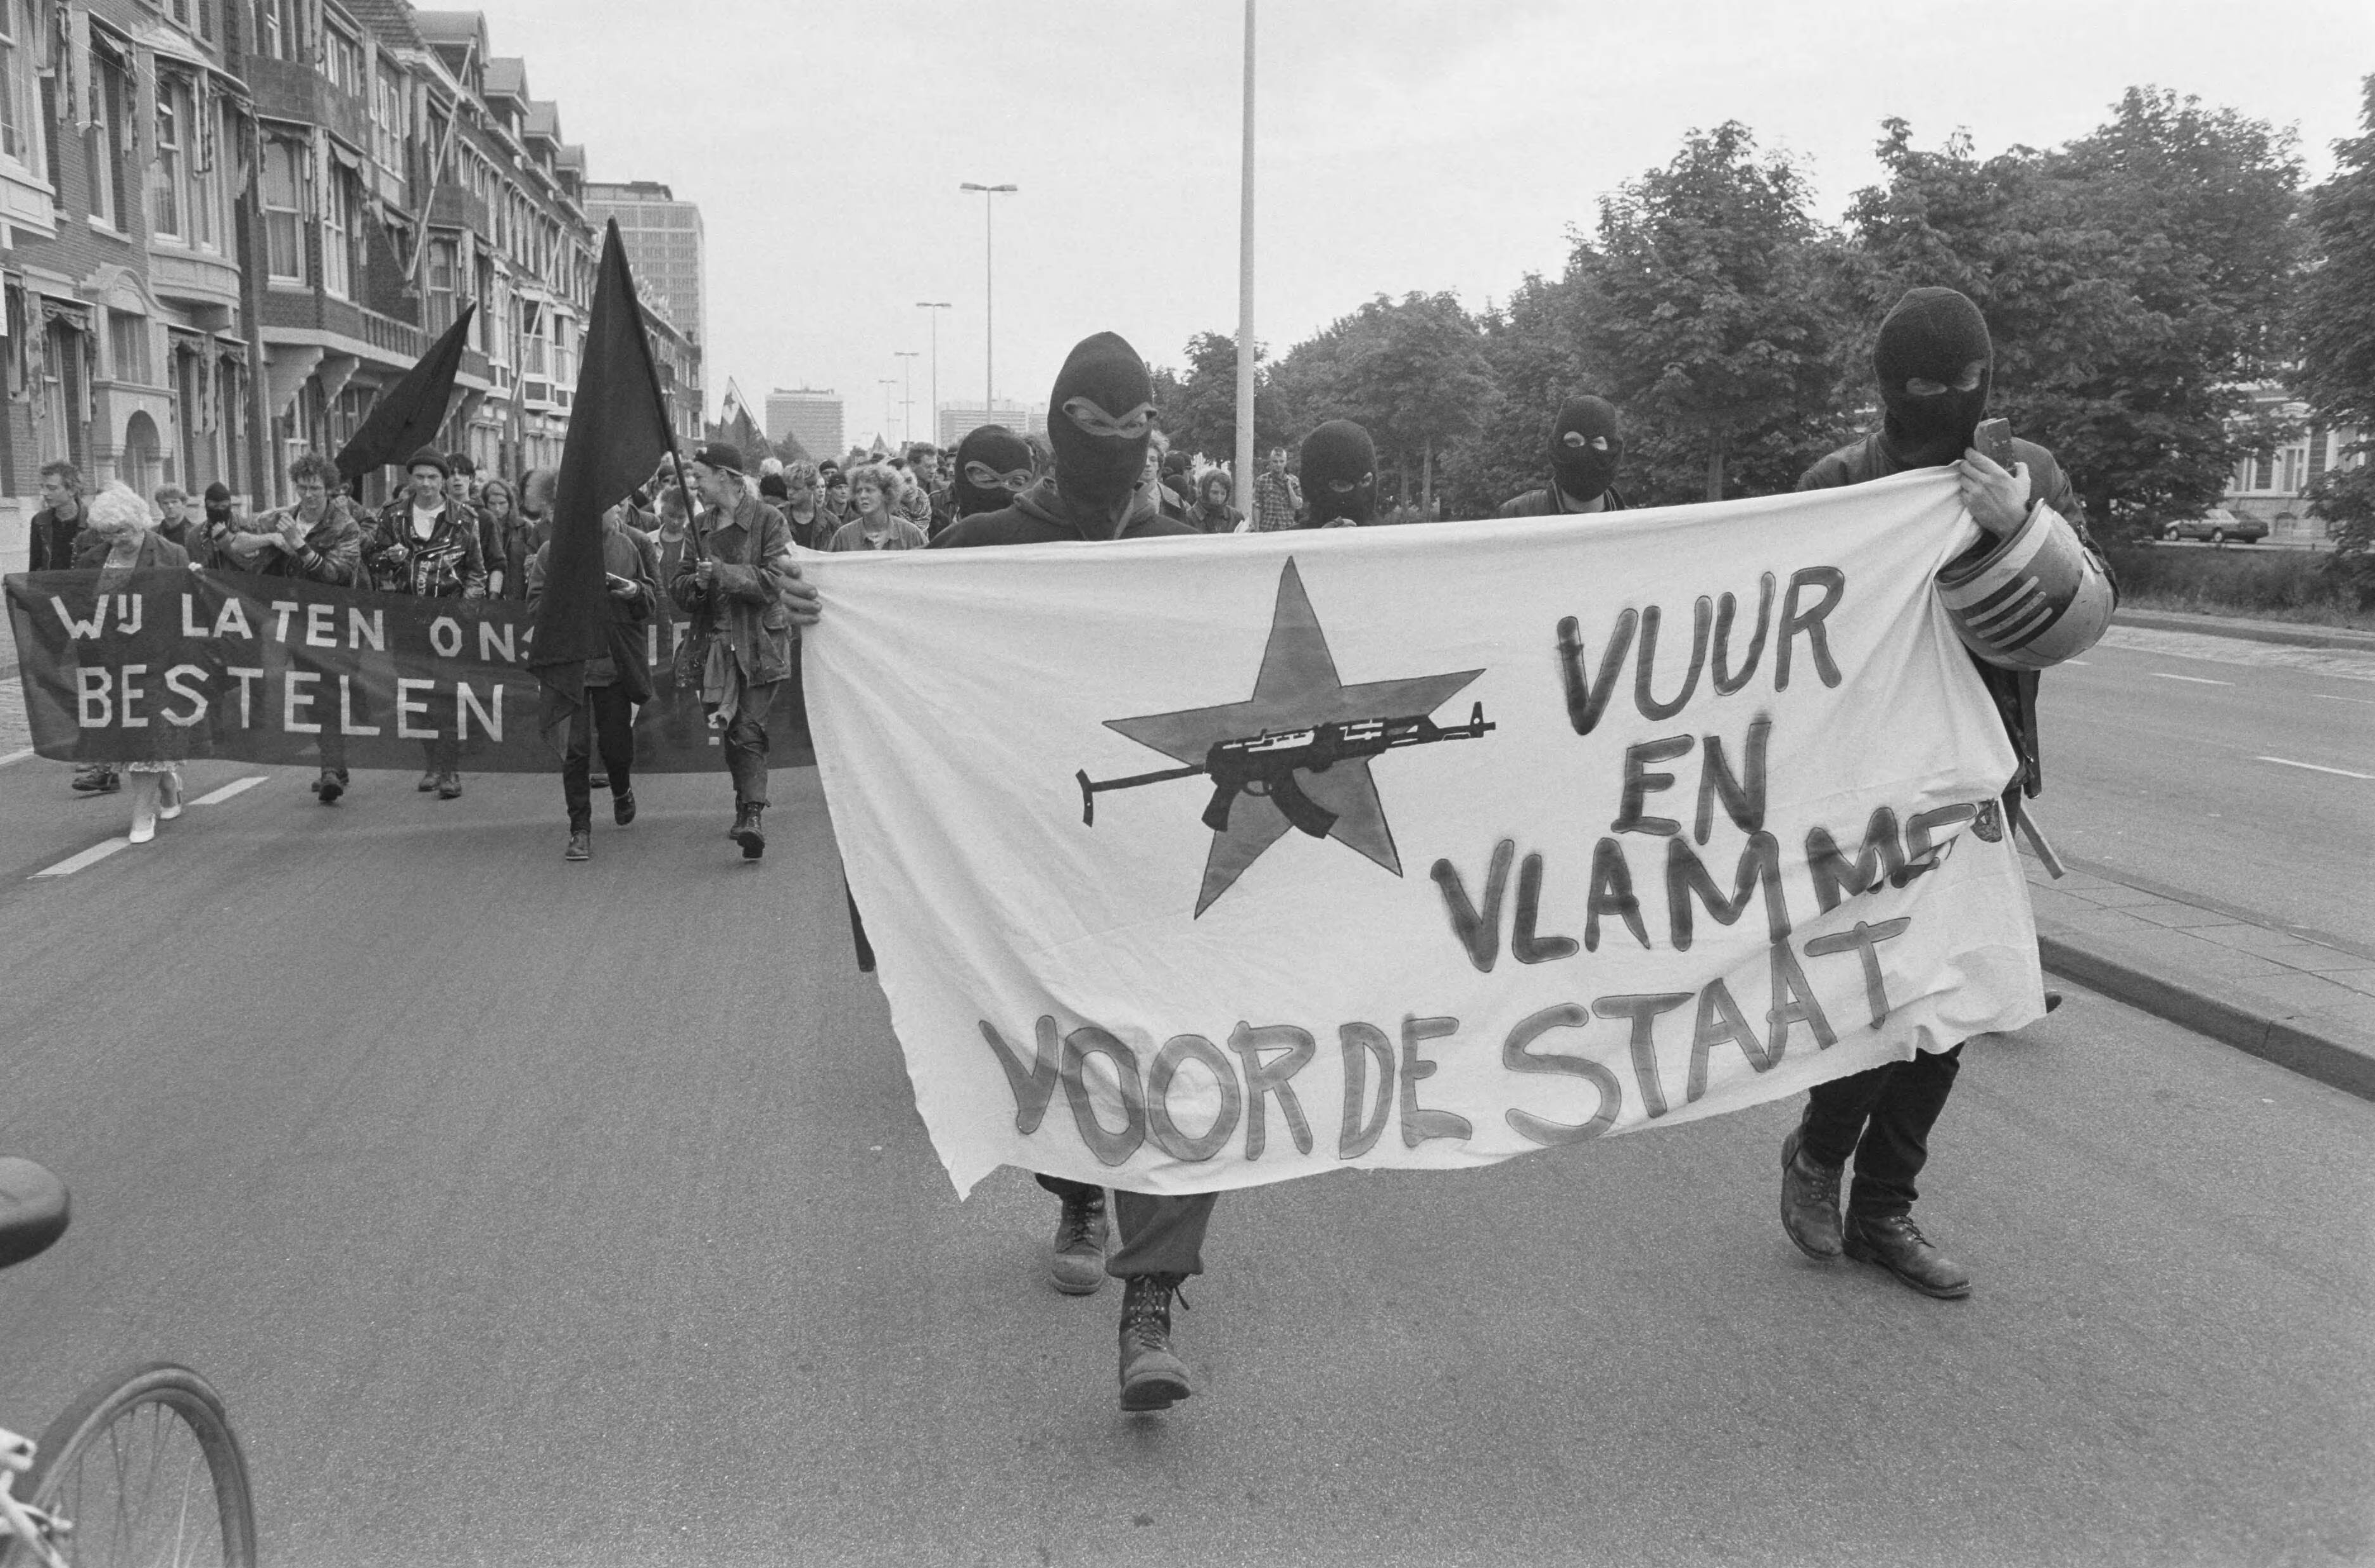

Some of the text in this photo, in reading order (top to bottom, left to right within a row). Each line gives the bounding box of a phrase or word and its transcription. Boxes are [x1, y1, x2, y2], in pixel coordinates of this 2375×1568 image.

[50, 594, 142, 639] WIJ
[181, 593, 385, 651] LATEN
[1557, 566, 1845, 736] VUUR
[76, 664, 504, 742] BESTELEN
[1610, 713, 1773, 845] EN
[978, 917, 1911, 1167] VOOR DE STAAT
